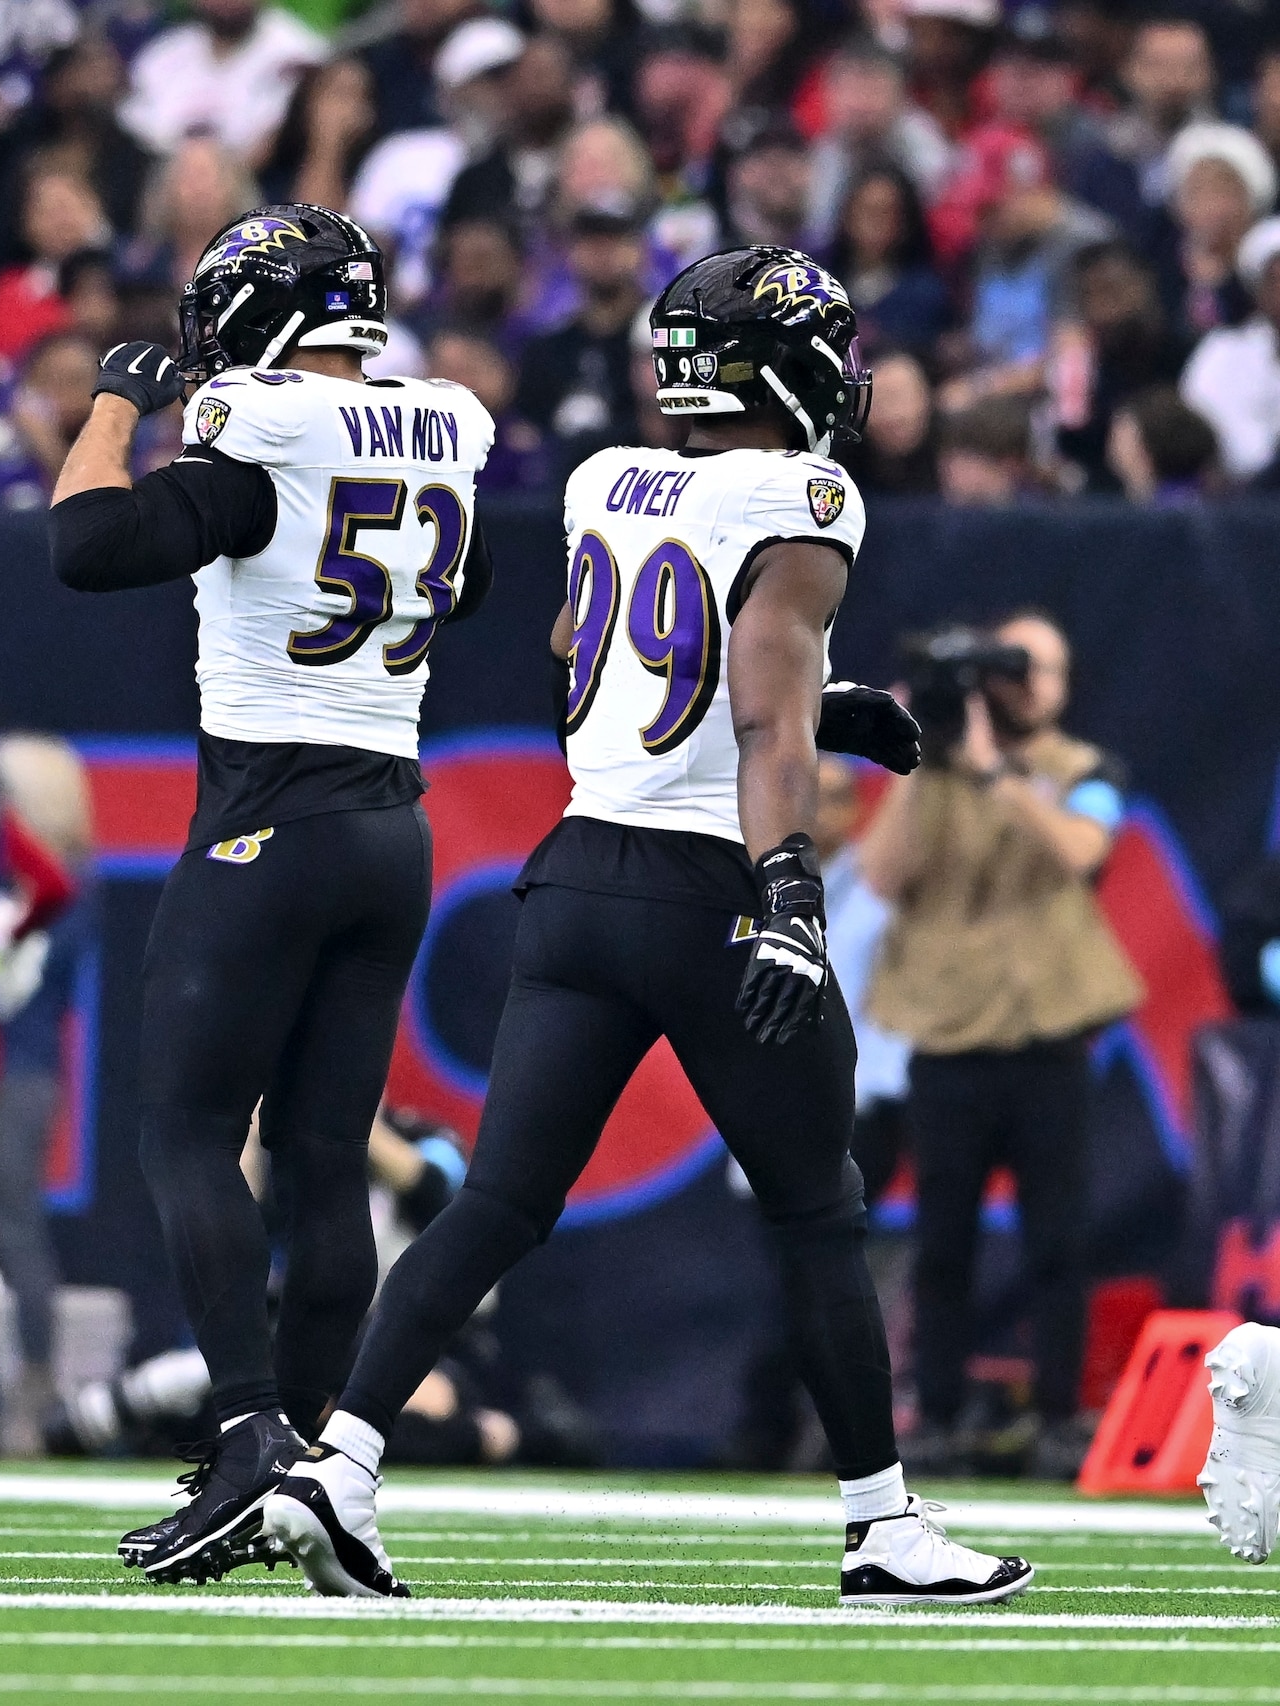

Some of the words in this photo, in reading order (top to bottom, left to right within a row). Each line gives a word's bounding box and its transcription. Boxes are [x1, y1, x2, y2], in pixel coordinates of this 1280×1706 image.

[338, 405, 404, 457] VAN
[412, 407, 458, 462] NOY
[606, 467, 696, 517] OWEH
[810, 479, 843, 491] RAVENS
[287, 476, 467, 676] 53
[566, 528, 721, 756] 99
